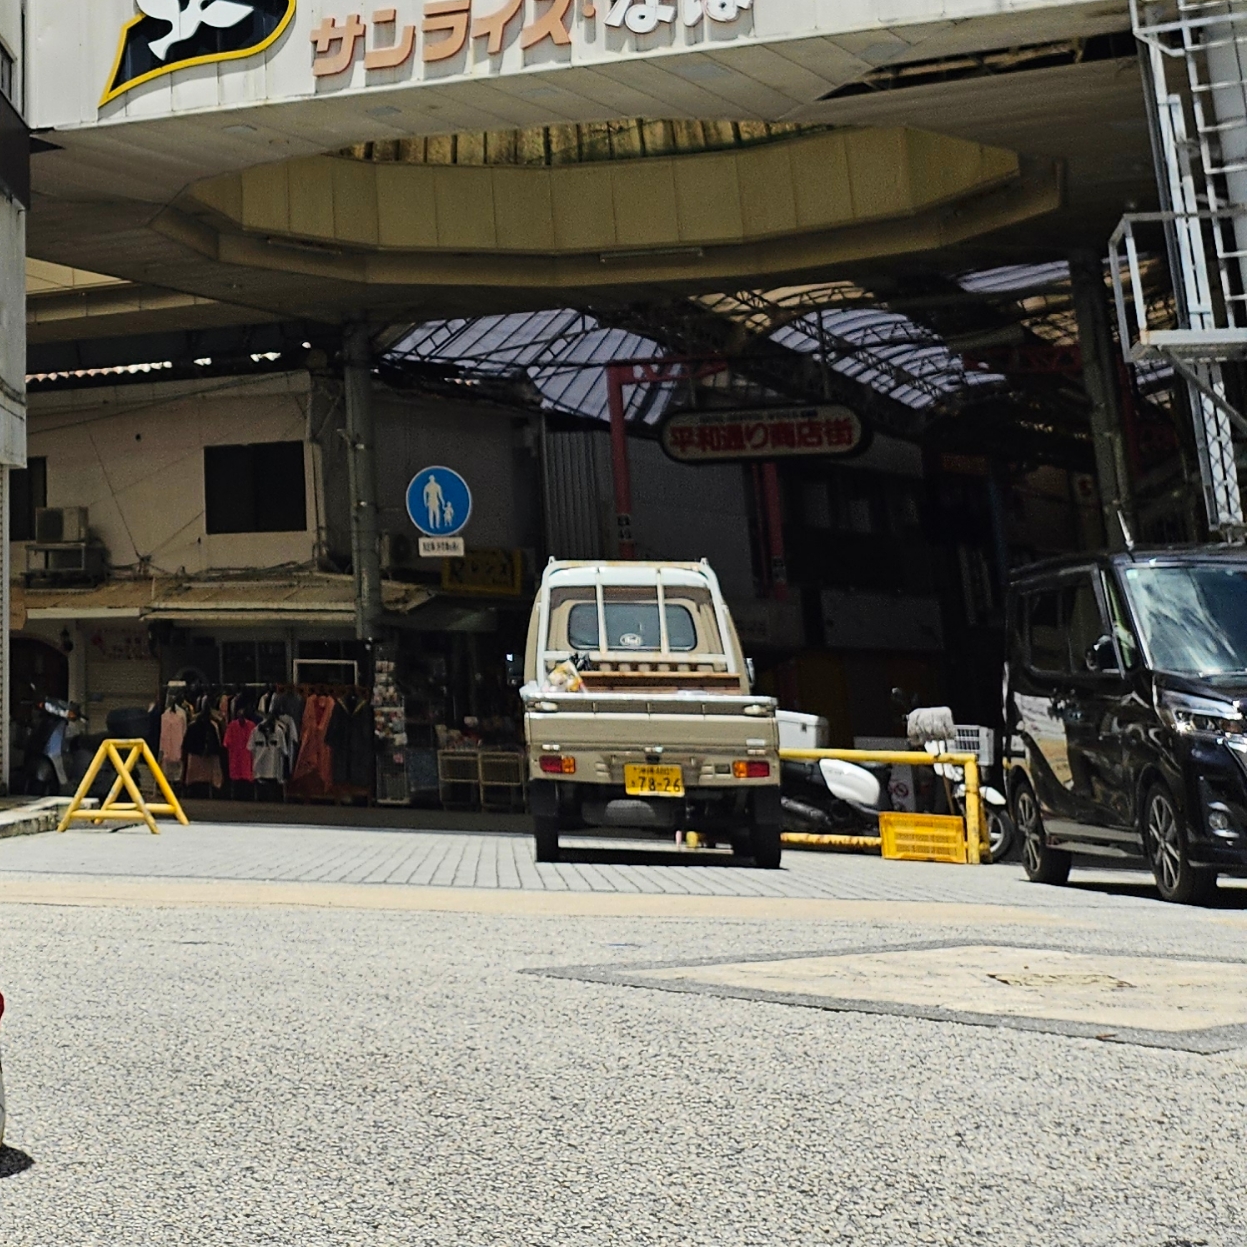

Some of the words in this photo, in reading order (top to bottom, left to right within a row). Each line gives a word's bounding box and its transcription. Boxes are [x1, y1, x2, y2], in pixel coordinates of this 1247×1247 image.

[670, 419, 852, 452] 平和通り商店街
